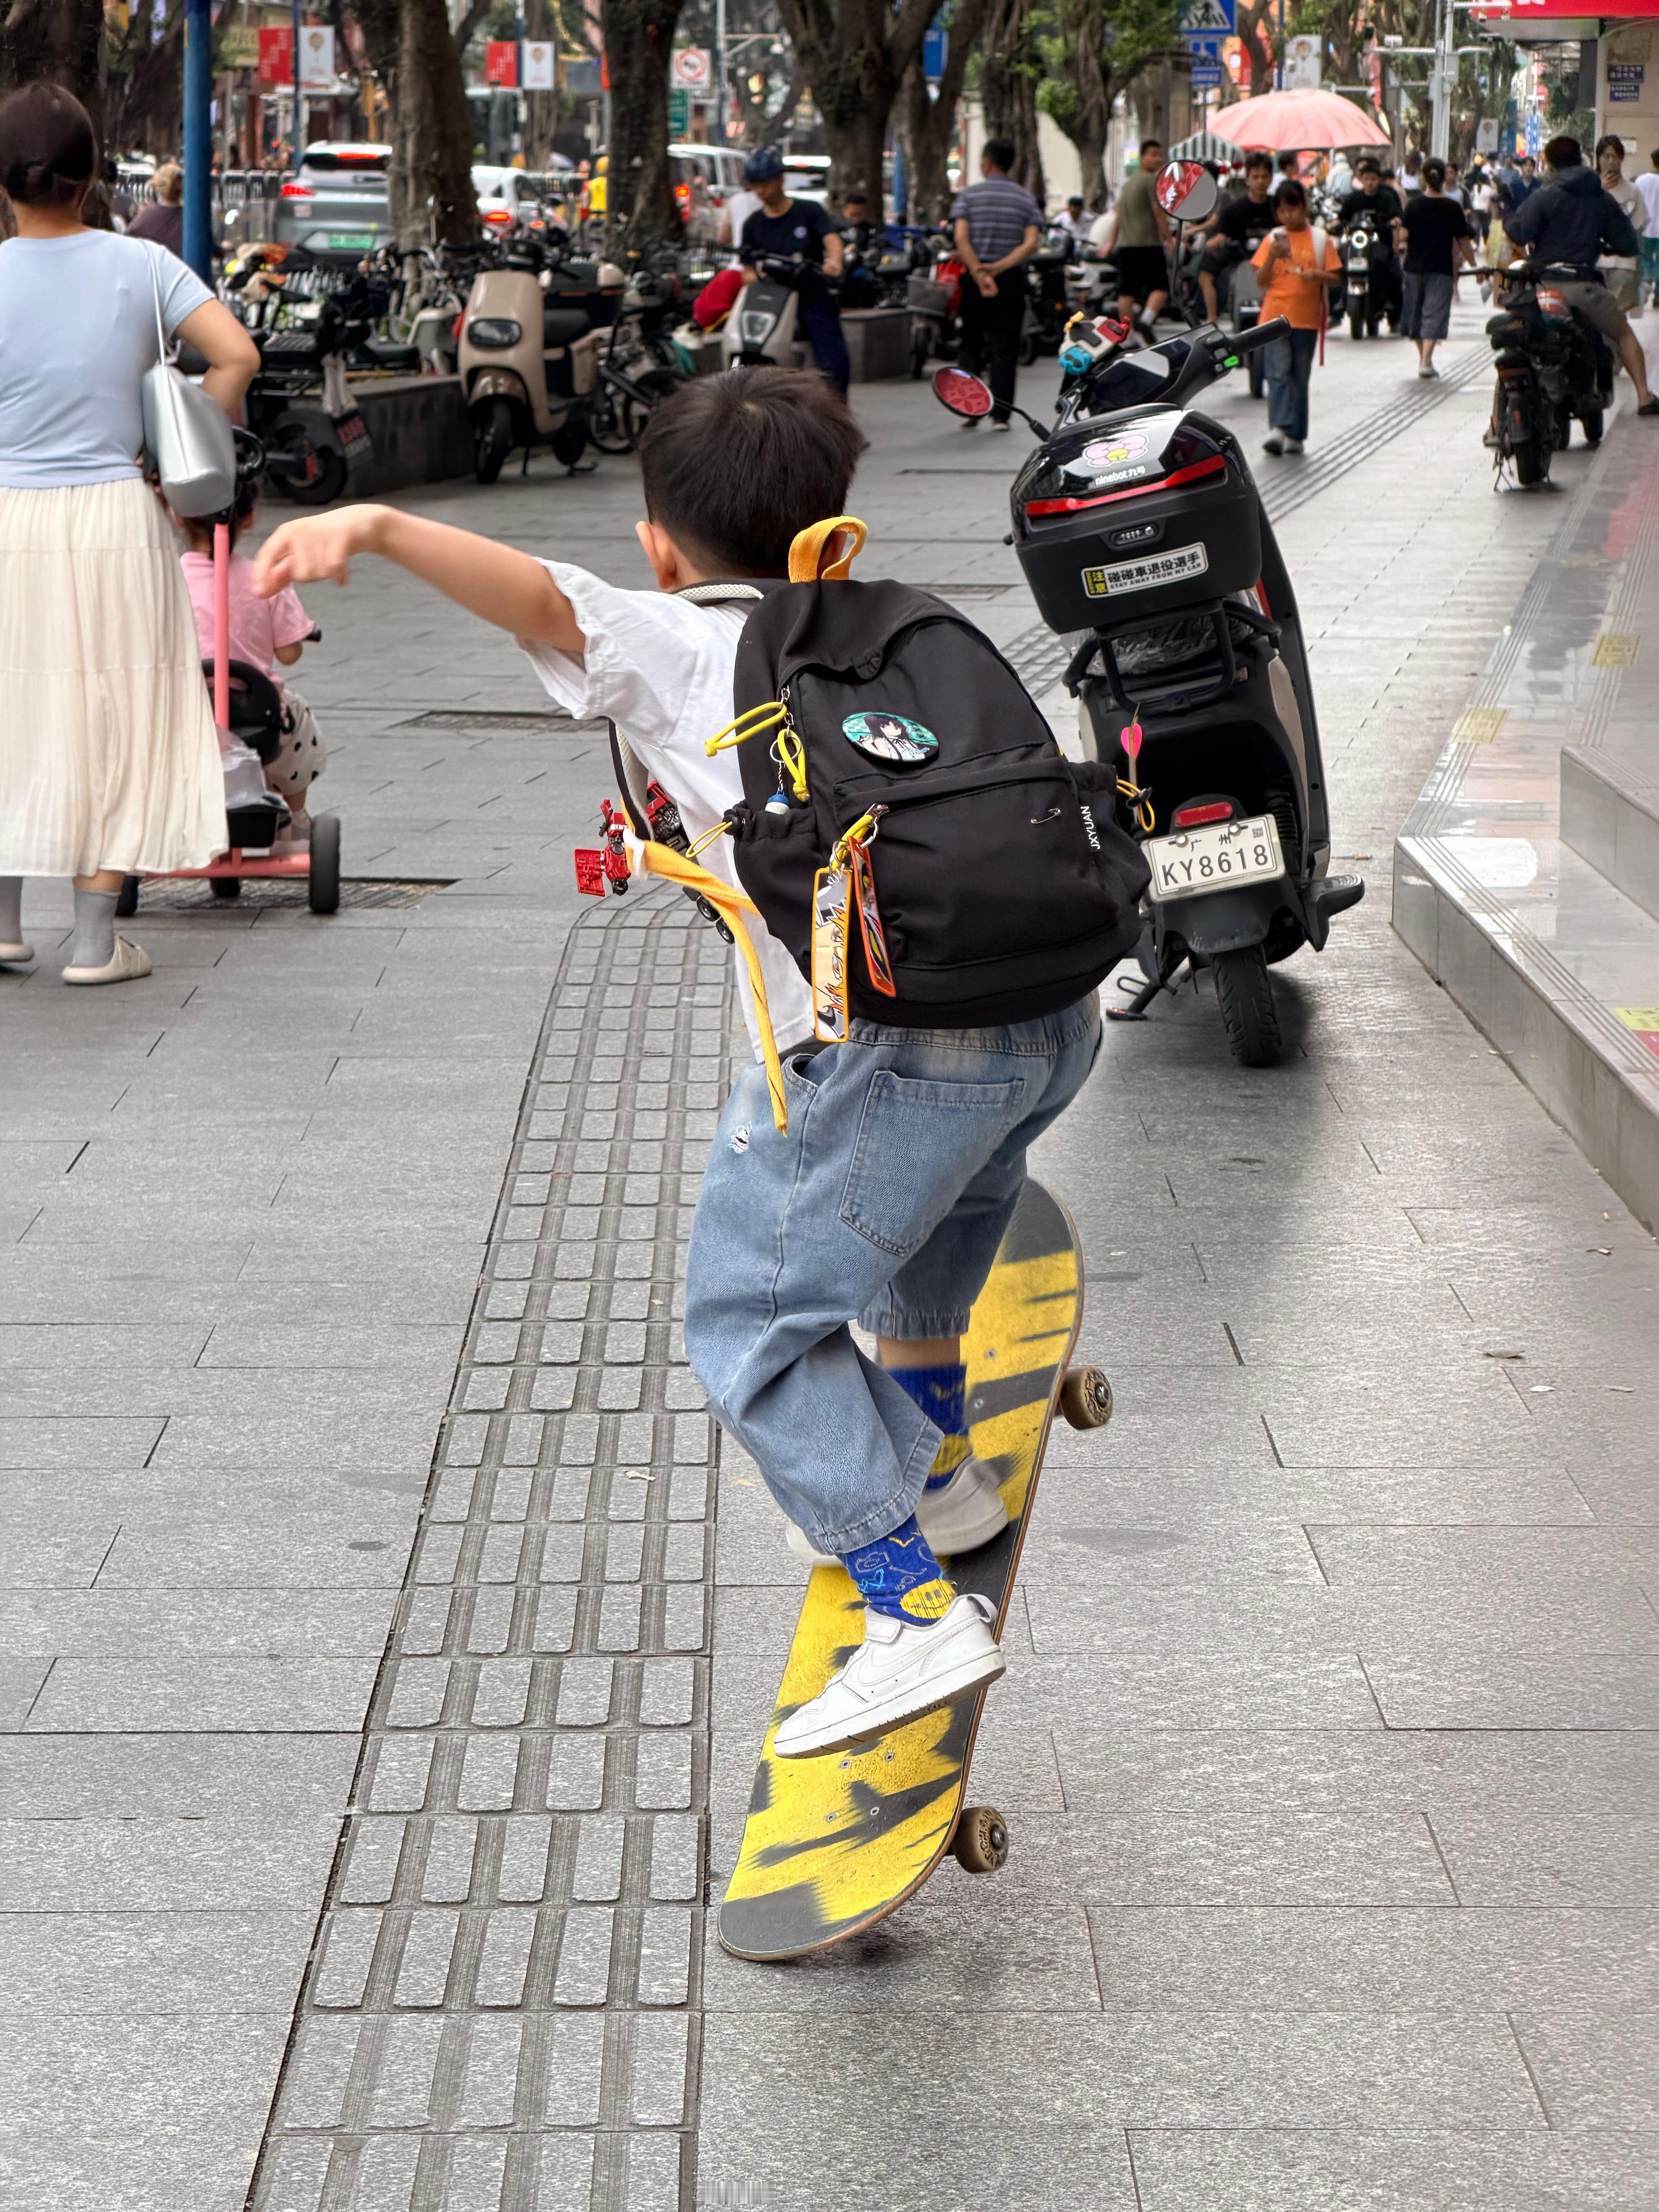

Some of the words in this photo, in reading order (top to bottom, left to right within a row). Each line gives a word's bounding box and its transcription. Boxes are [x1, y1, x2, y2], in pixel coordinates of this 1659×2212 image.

[1130, 576, 1149, 585] AWAY
[1152, 571, 1173, 580] FROM
[1187, 563, 1200, 571] CAR
[1080, 806, 1101, 850] JXYUAN
[1162, 844, 1268, 886] KY8618
